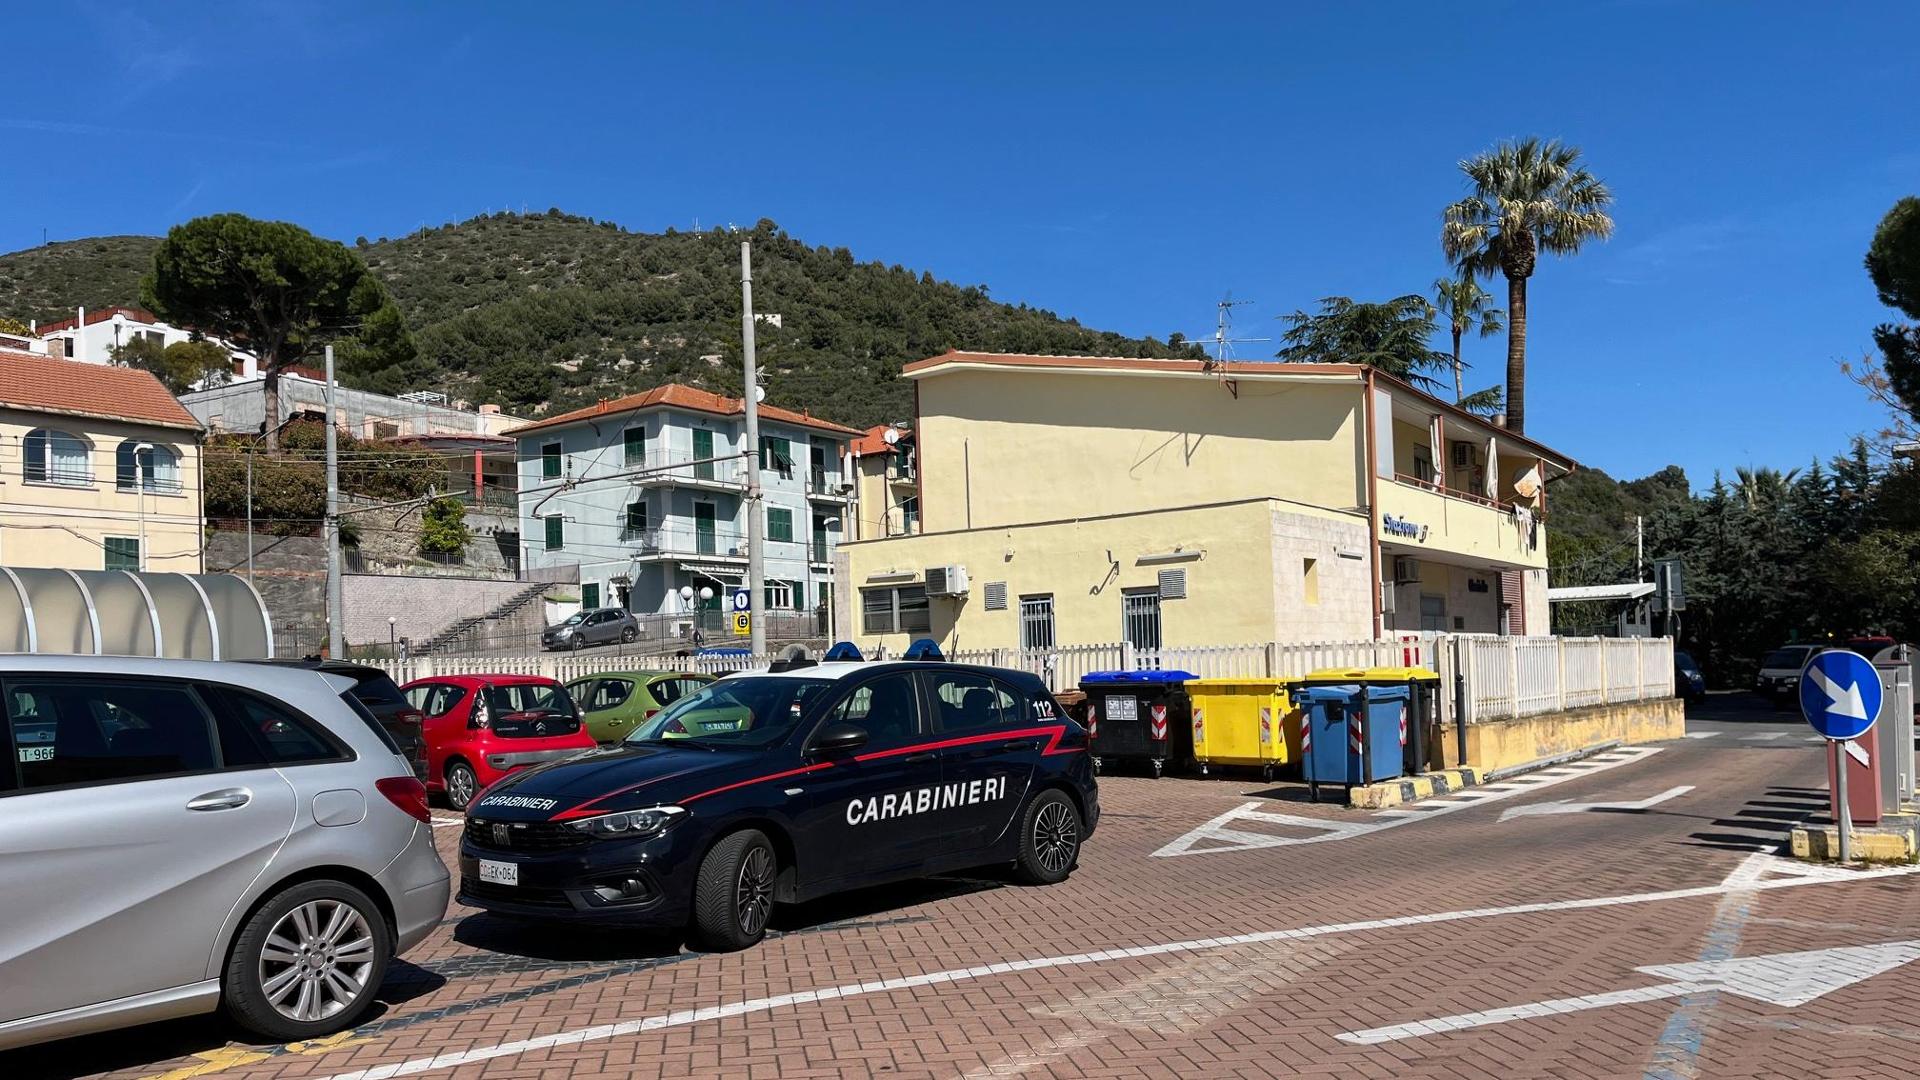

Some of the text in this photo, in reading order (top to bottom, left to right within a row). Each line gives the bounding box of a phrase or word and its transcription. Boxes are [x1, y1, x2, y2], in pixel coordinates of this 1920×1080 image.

[1033, 700, 1055, 718] 112
[481, 796, 558, 810] CARABINIERI
[847, 776, 1006, 826] CARABINIERI
